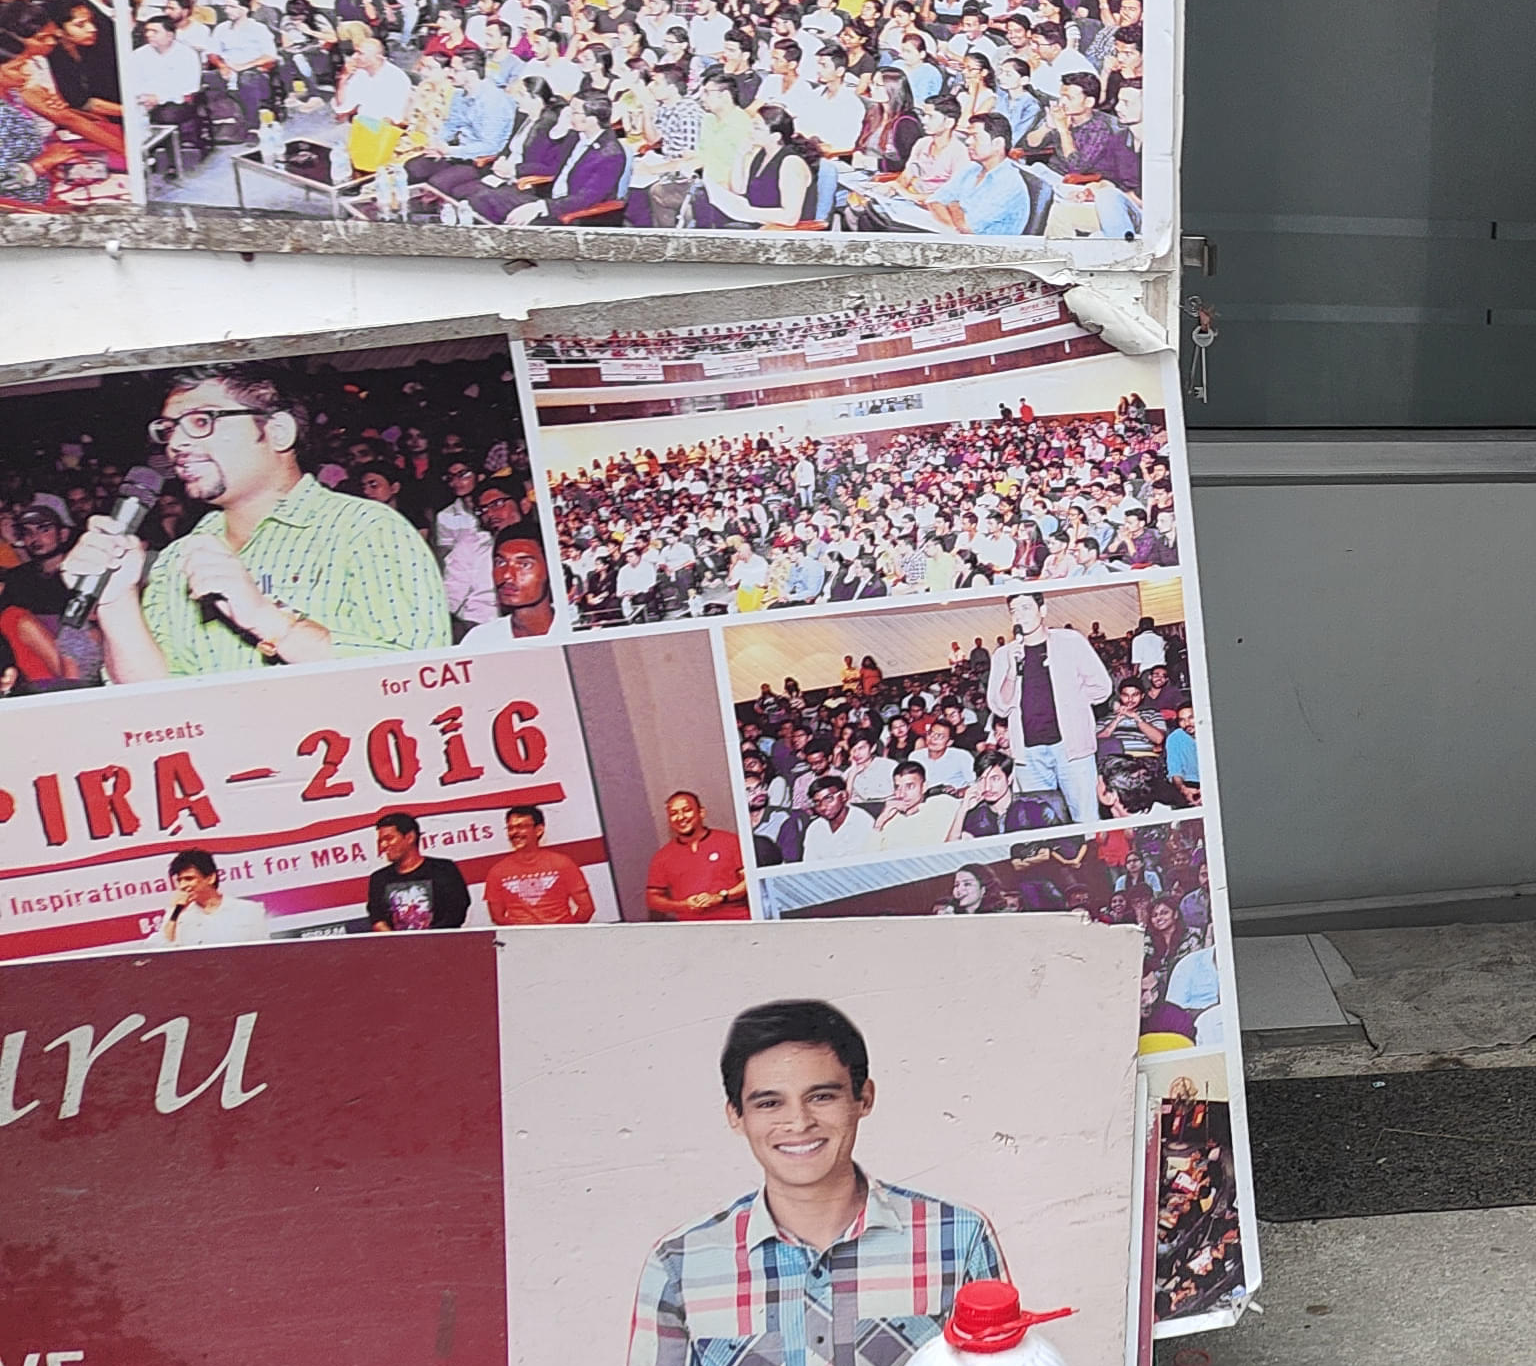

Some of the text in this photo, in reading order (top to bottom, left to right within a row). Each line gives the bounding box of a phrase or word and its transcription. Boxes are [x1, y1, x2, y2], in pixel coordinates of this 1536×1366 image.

[381, 660, 474, 697] for CAT
[124, 721, 205, 749] Presents
[10, 873, 177, 916] Inspirational
[263, 853, 301, 876] for
[312, 841, 367, 869] MBA
